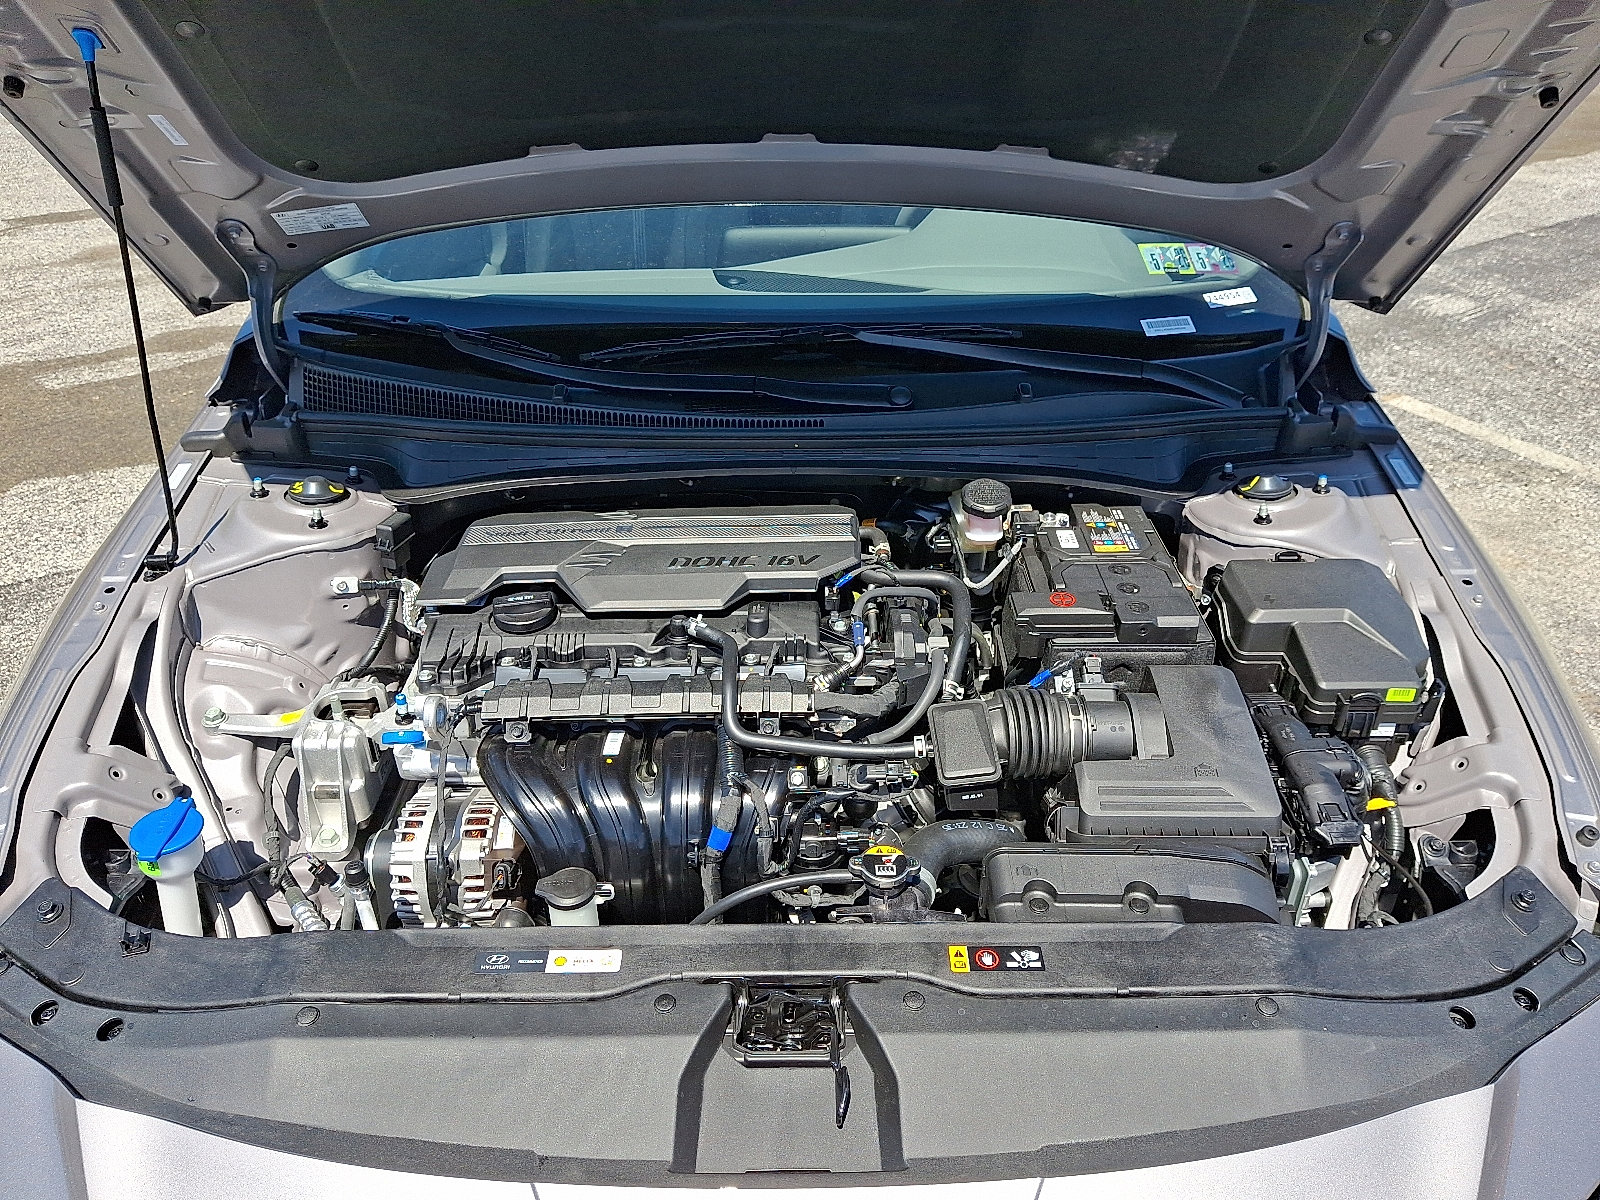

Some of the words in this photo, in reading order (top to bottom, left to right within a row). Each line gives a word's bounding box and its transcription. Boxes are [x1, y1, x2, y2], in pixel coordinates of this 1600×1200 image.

[1150, 253, 1160, 270] 5
[1196, 252, 1206, 269] 5
[667, 555, 761, 569] DOHC
[767, 554, 822, 568] 16V
